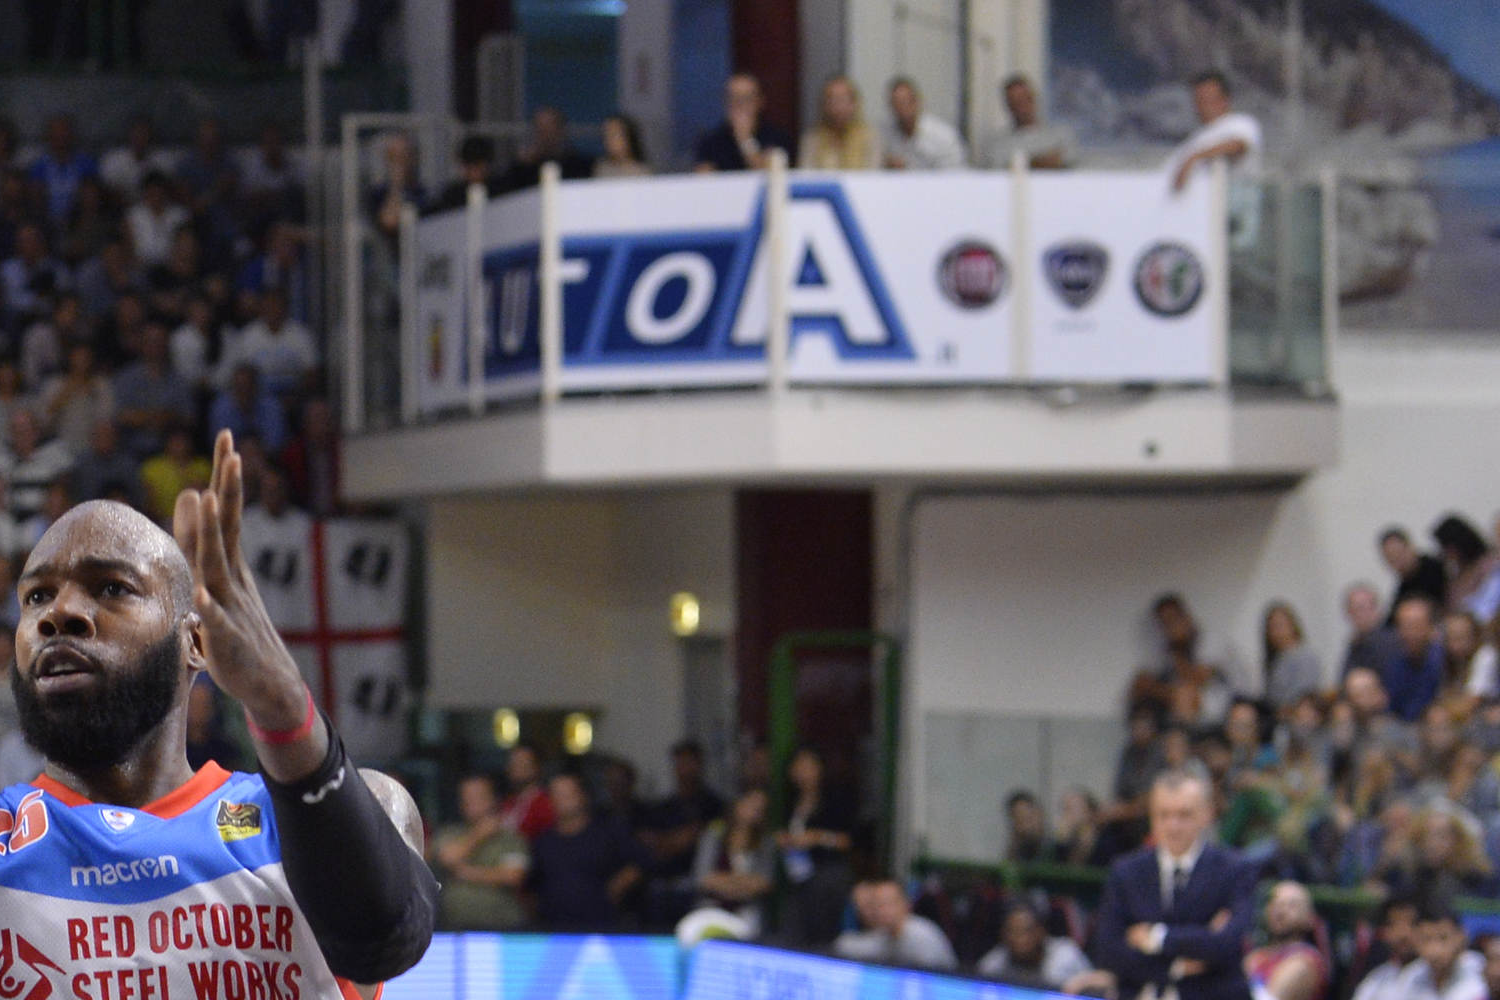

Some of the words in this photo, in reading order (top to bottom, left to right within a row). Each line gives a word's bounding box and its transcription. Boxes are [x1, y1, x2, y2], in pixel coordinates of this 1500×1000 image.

[71, 855, 179, 886] macron
[67, 915, 136, 961] RED
[148, 903, 294, 953] OCTOBER
